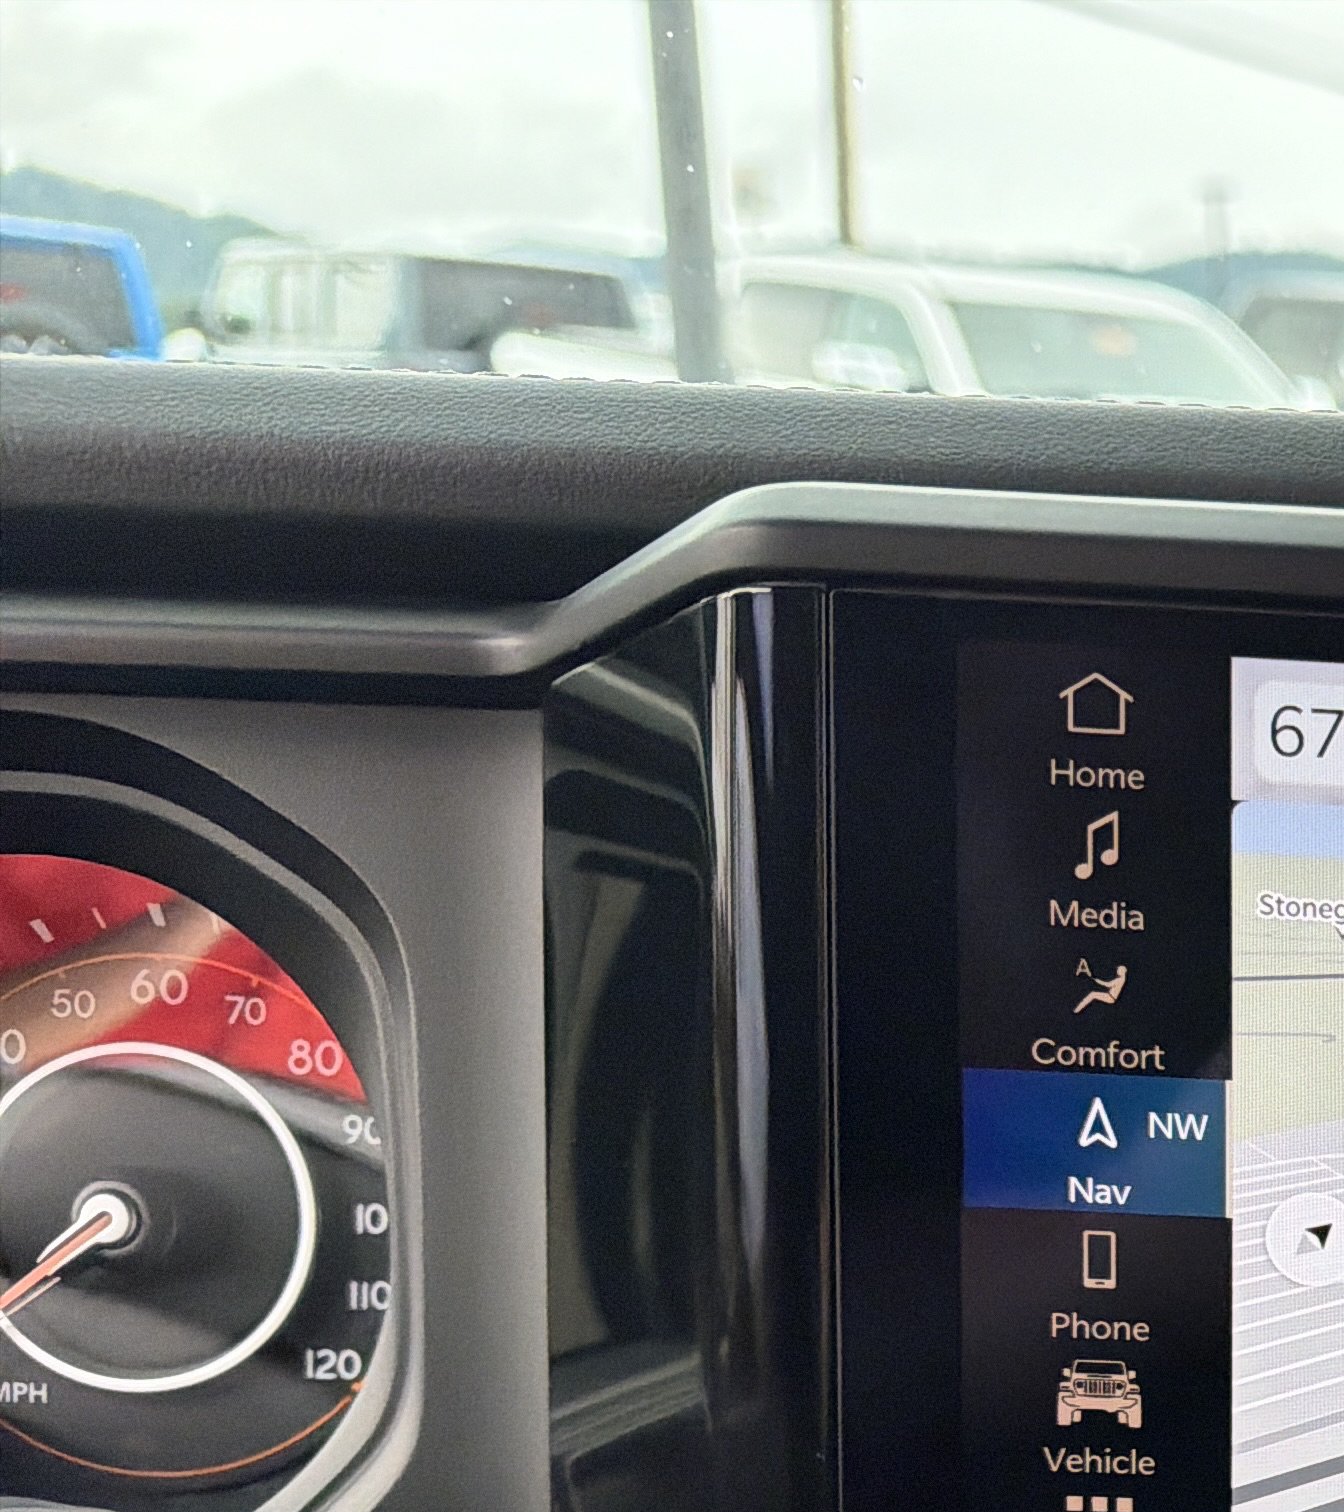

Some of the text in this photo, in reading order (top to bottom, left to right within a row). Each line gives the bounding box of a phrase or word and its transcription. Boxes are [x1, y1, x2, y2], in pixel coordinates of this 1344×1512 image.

[1050, 759, 1146, 790] Home
[1049, 900, 1146, 932] Media
[130, 968, 189, 1007] 60
[50, 988, 96, 1019] 50
[225, 994, 267, 1026] 70
[287, 1038, 343, 1077] 80
[1031, 1038, 1166, 1071] Comfort
[1147, 1112, 1209, 1142] NW
[1067, 1176, 1132, 1206] Nav
[349, 1280, 391, 1311] 110
[1050, 1312, 1150, 1343] Phone
[304, 1348, 362, 1380] 120
[1042, 1446, 1156, 1477] Vehicle
